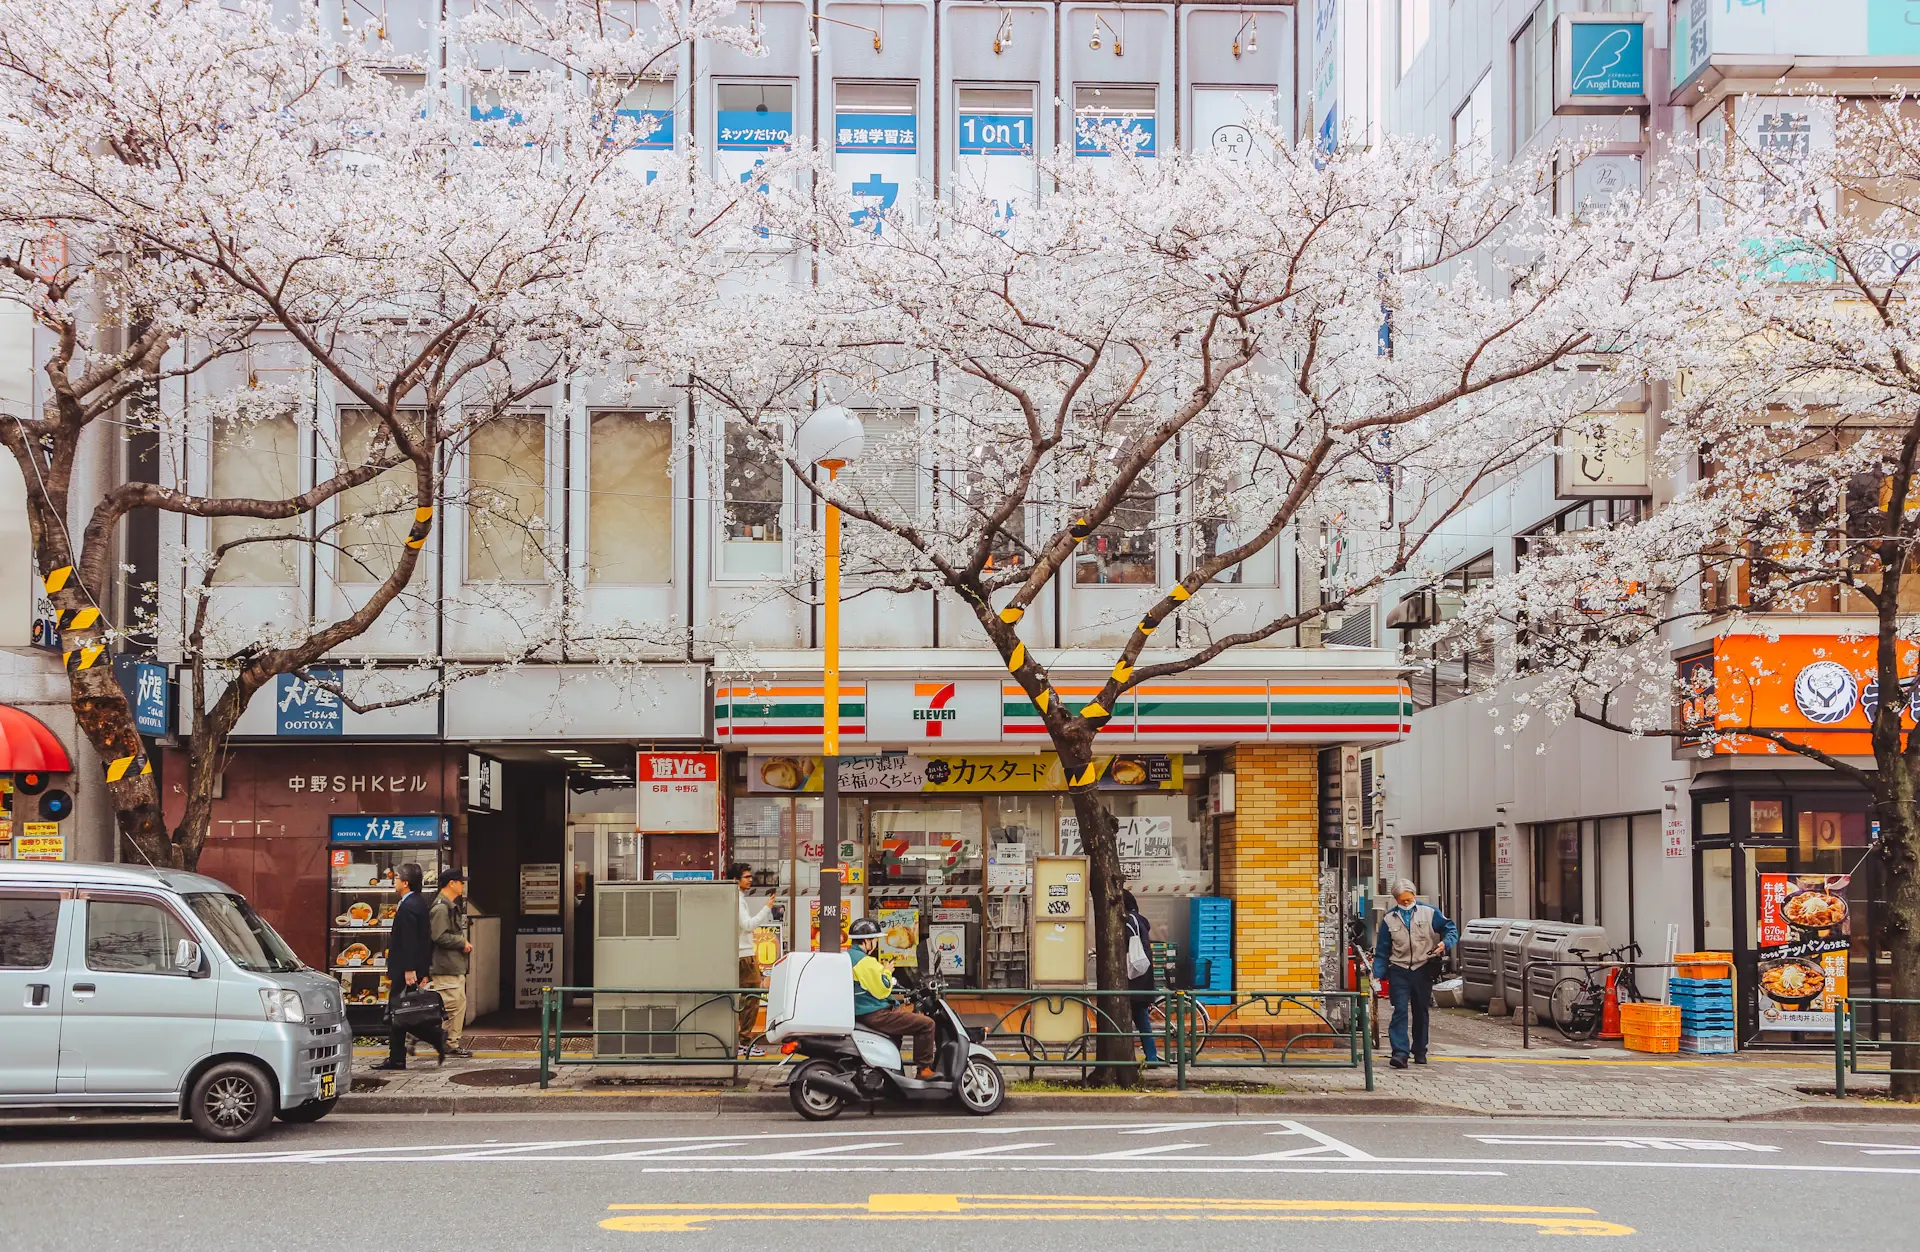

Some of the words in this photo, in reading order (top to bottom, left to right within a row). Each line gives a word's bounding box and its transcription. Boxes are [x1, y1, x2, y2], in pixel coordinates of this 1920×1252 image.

[1586, 79, 1611, 90] Angel
[1612, 79, 1640, 88] Dream
[721, 127, 789, 142] ネッツだけの
[838, 128, 915, 145] 最強学習法
[137, 669, 164, 708] 大戸屋
[138, 715, 162, 728] OOTOYA
[284, 720, 335, 730] OOTOYA
[838, 756, 907, 772] っとり濃厚
[952, 759, 1047, 785] カスタード
[288, 774, 428, 793] 中野SHKビル
[675, 784, 699, 793] 中野店
[364, 816, 408, 841] 大戸屋
[1061, 828, 1080, 837] 揚げ
[840, 844, 854, 857] 酒
[525, 962, 554, 974] ネッツ
